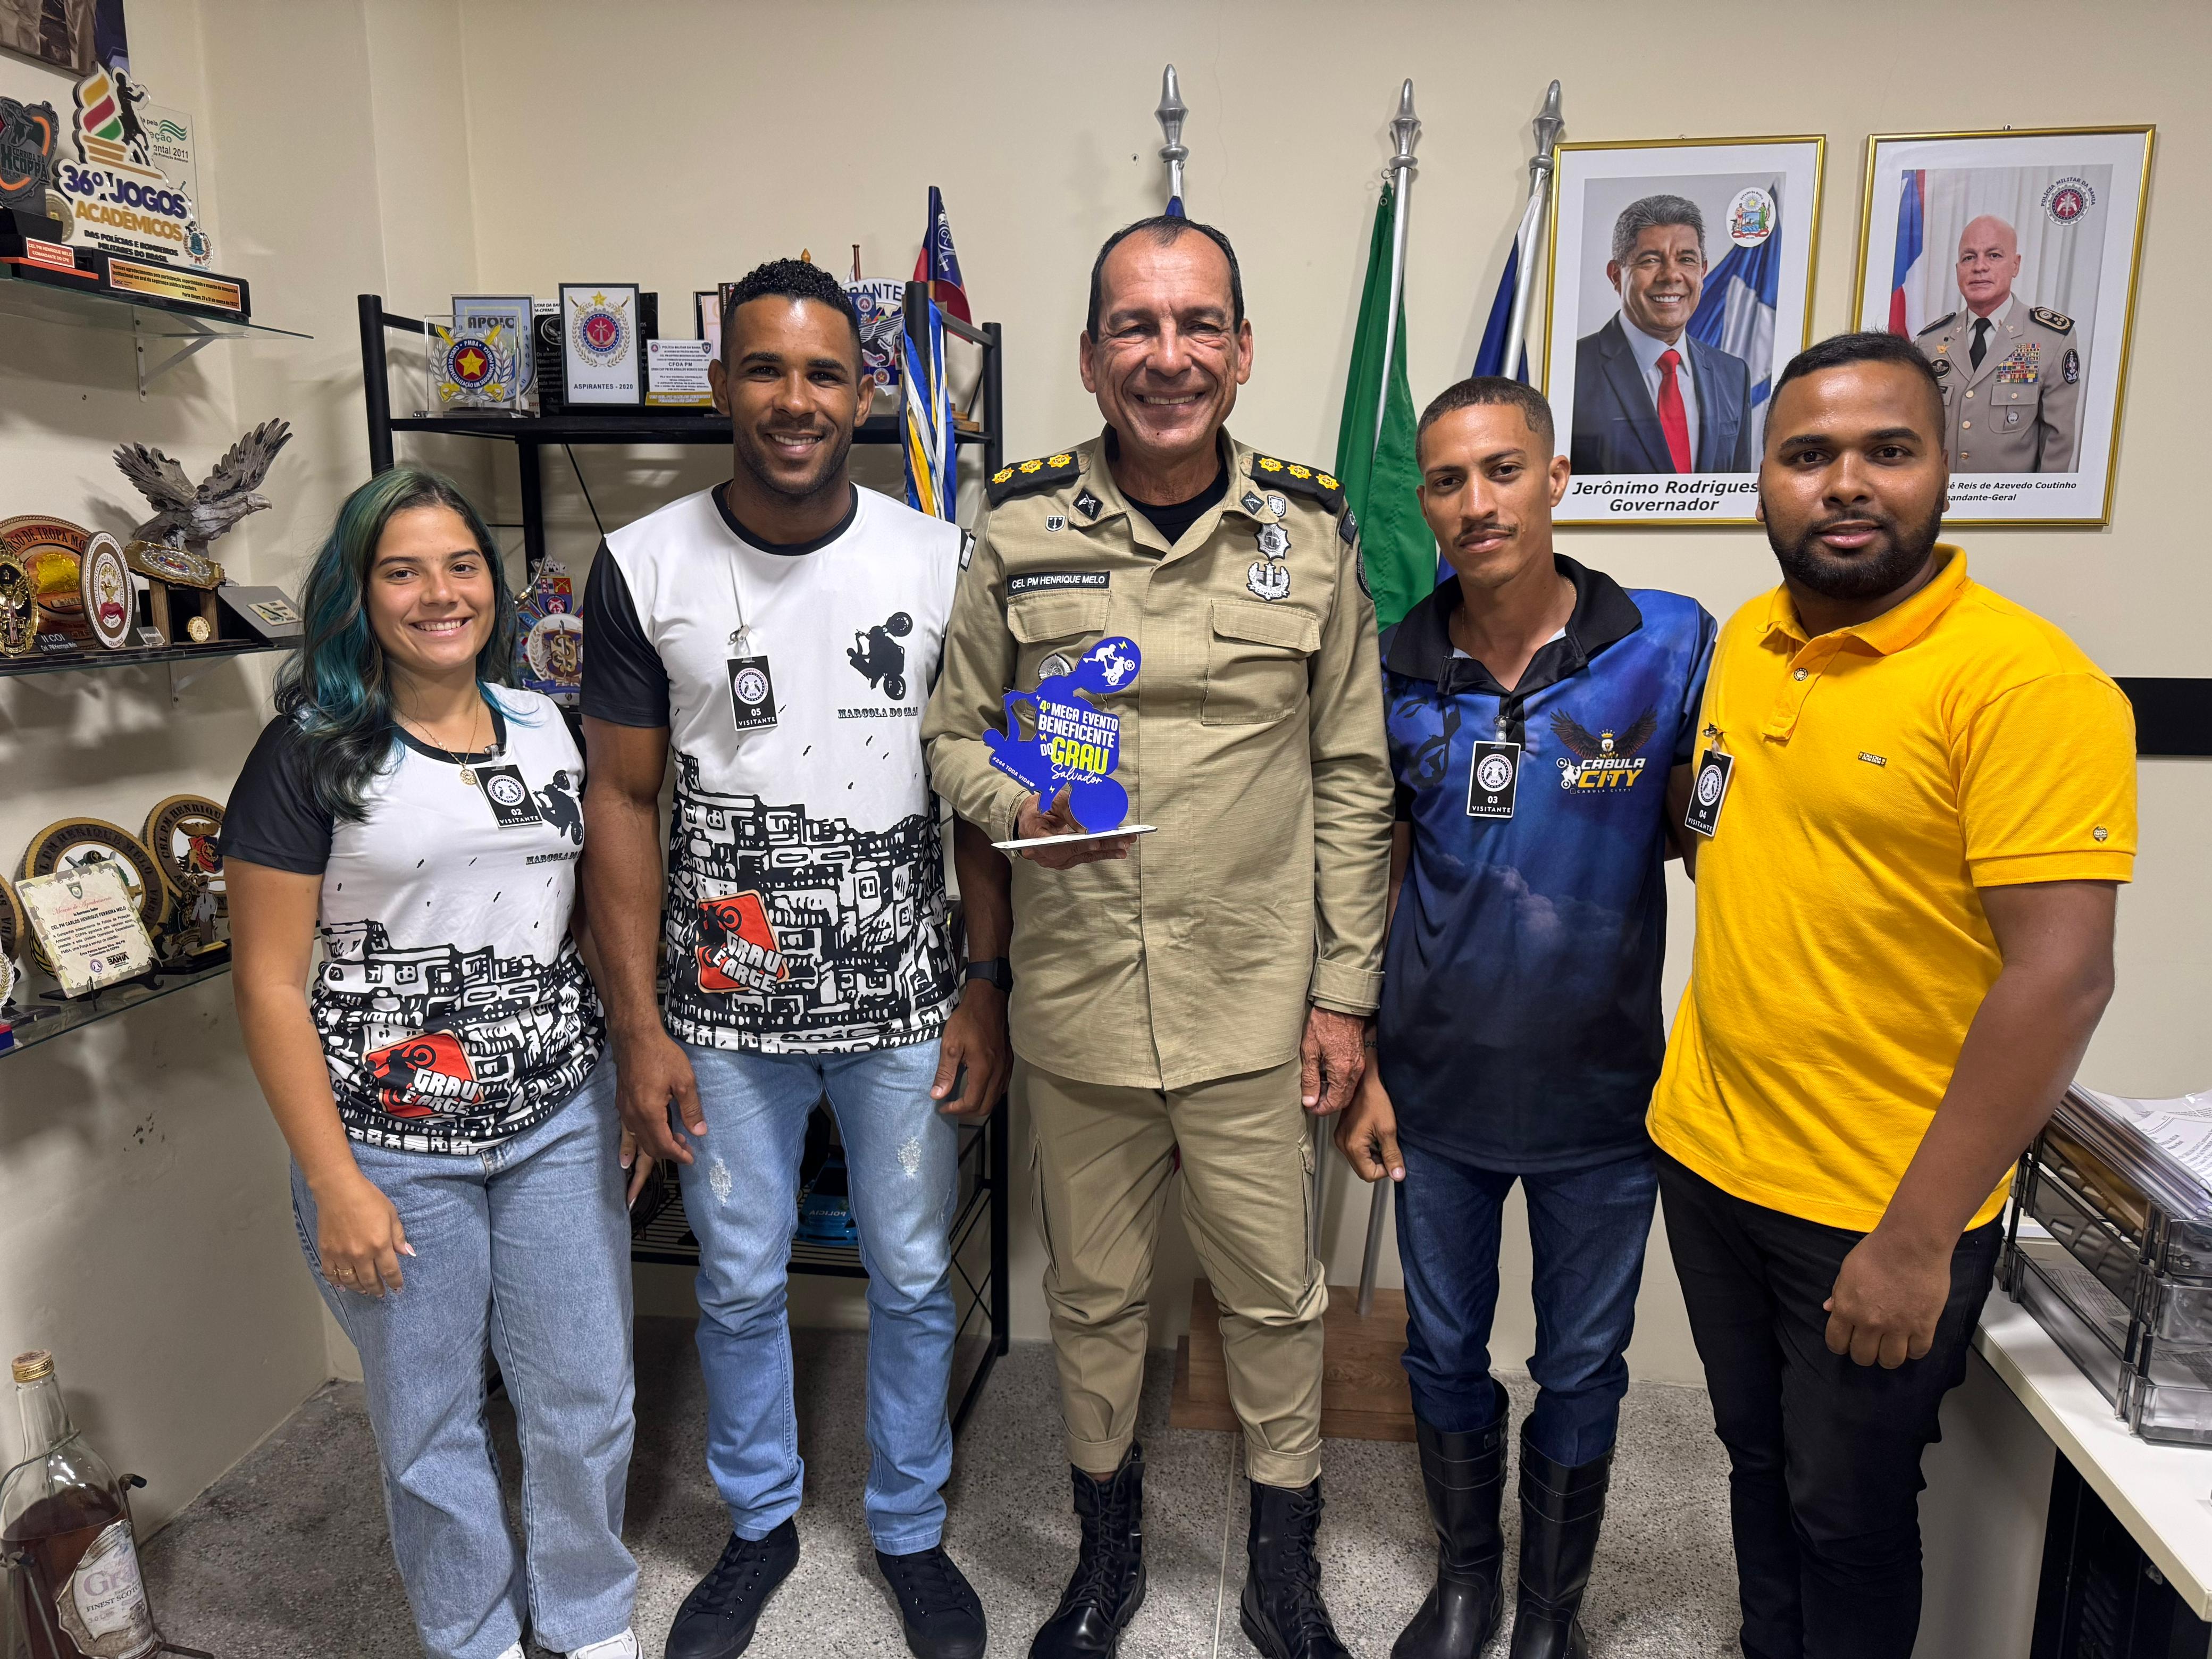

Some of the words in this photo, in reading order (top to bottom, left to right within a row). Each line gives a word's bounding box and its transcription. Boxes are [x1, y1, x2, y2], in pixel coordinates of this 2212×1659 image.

[12, 148, 35, 161] CORRIDA
[173, 148, 188, 158] 2011
[13, 156, 48, 181] COPPA
[109, 179, 187, 219] JOGOS
[2041, 185, 2055, 207] POLÍCIA
[2088, 187, 2096, 206] BAHIA
[76, 200, 183, 241] ACADÊMICOS
[84, 230, 99, 239] DAS
[101, 233, 133, 247] POLÍCIAS
[140, 242, 179, 257] BOMBEIROS
[98, 242, 133, 255] MILITARES
[146, 252, 169, 263] BRASIL
[449, 365, 473, 388] ESPECIALIZAÇÃO
[480, 364, 495, 385] SEGURANÇA
[1572, 481, 1658, 495] Jerônimo
[1665, 480, 1758, 496] Rodrigues
[1610, 498, 1719, 512] Governador
[23, 528, 38, 542] DE
[36, 527, 68, 543] TROPA
[1012, 579, 1025, 589] CEL
[1027, 577, 1038, 586] PM
[1040, 575, 1082, 585] HENRIQUE
[1082, 575, 1105, 584] MELO
[48, 633, 65, 642] COI
[739, 717, 776, 726] VISITANTE
[837, 708, 887, 718] MARCOLA
[890, 708, 902, 717] DO
[1040, 700, 1050, 713] 4º
[1051, 703, 1080, 722] MEGA
[1082, 711, 1118, 731] EVENTO
[1038, 714, 1116, 748] BENEFICENTE
[1040, 742, 1053, 756] DO
[1050, 736, 1109, 775] GRAU
[1581, 758, 1646, 769] CABULA
[992, 757, 1006, 767] #244
[1006, 765, 1018, 776] TODA
[1019, 774, 1030, 785] VIDA
[1051, 763, 1102, 784] Salvador
[1578, 769, 1643, 788] CITY
[1487, 795, 1498, 804] 03
[499, 815, 539, 824] VISITANTE
[1699, 809, 1707, 819] 04
[161, 817, 172, 832] PM
[1688, 817, 1713, 832] VISITANTE
[127, 844, 153, 875] MELO
[526, 852, 568, 865] MARCOLA
[52, 905, 72, 915] Menção
[79, 897, 112, 908] Agradecimento
[727, 929, 783, 974] GRAU
[414, 1068, 480, 1101] GRAU
[87, 1598, 114, 1612] FINEST
